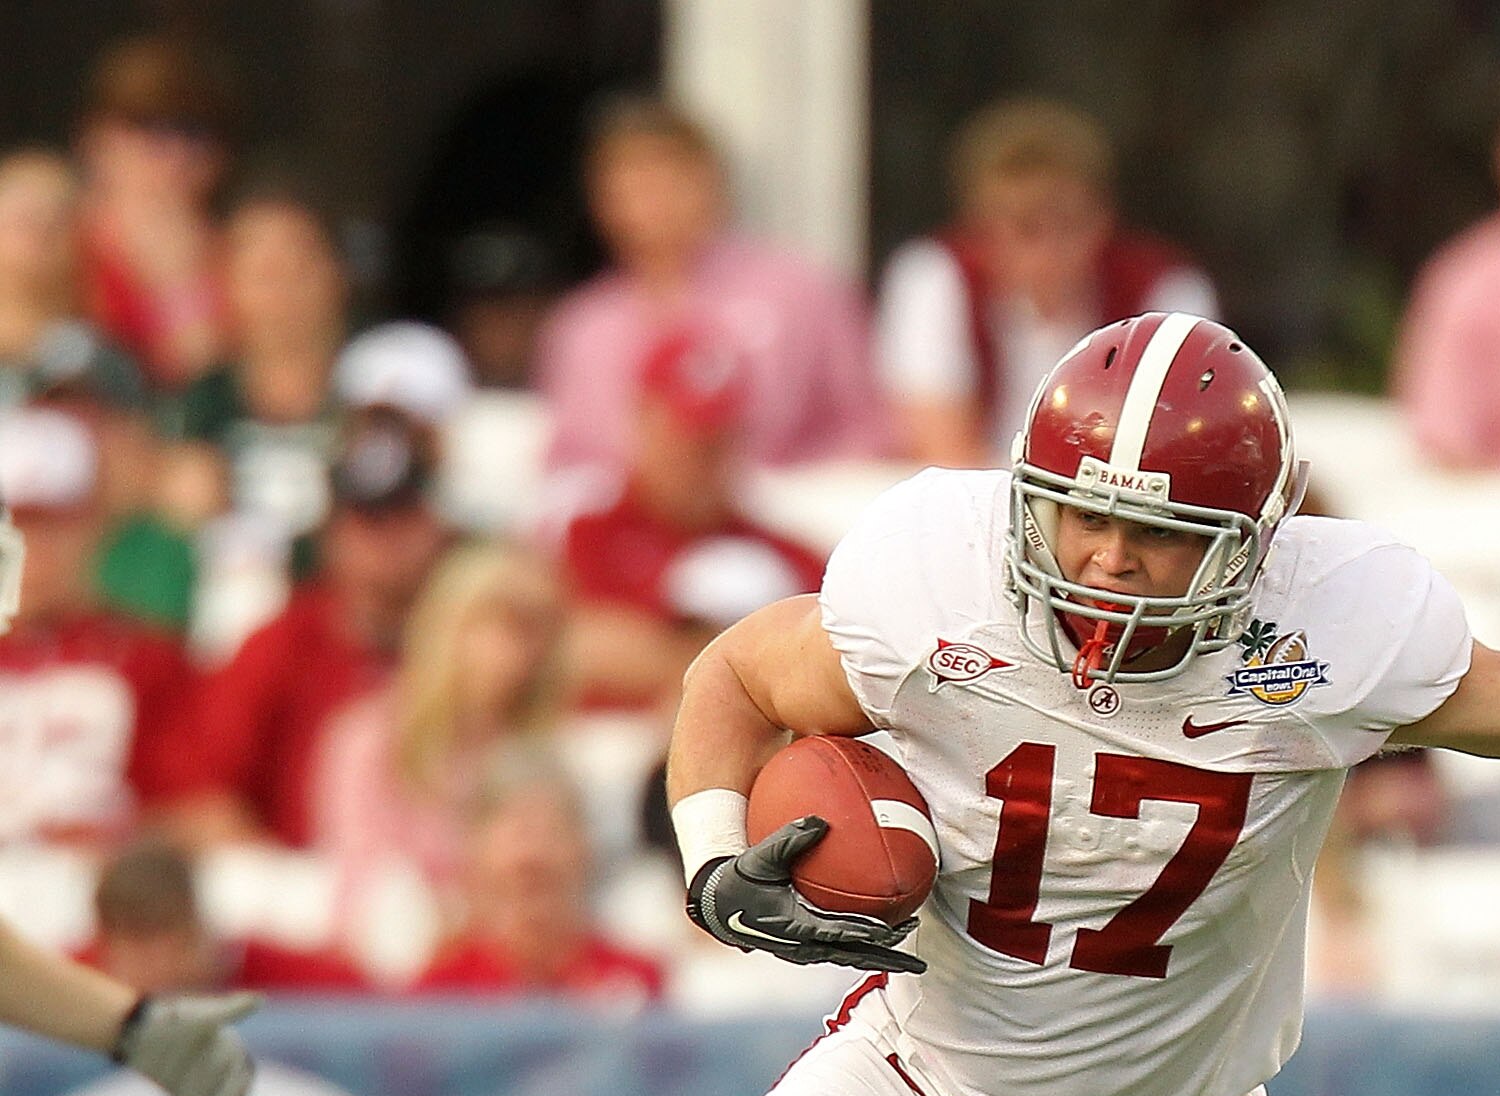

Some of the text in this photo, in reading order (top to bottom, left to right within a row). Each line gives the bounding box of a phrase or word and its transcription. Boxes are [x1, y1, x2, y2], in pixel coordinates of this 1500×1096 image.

[1098, 470, 1147, 492] BAMA
[938, 652, 980, 674] SEC
[966, 741, 1255, 979] 17
